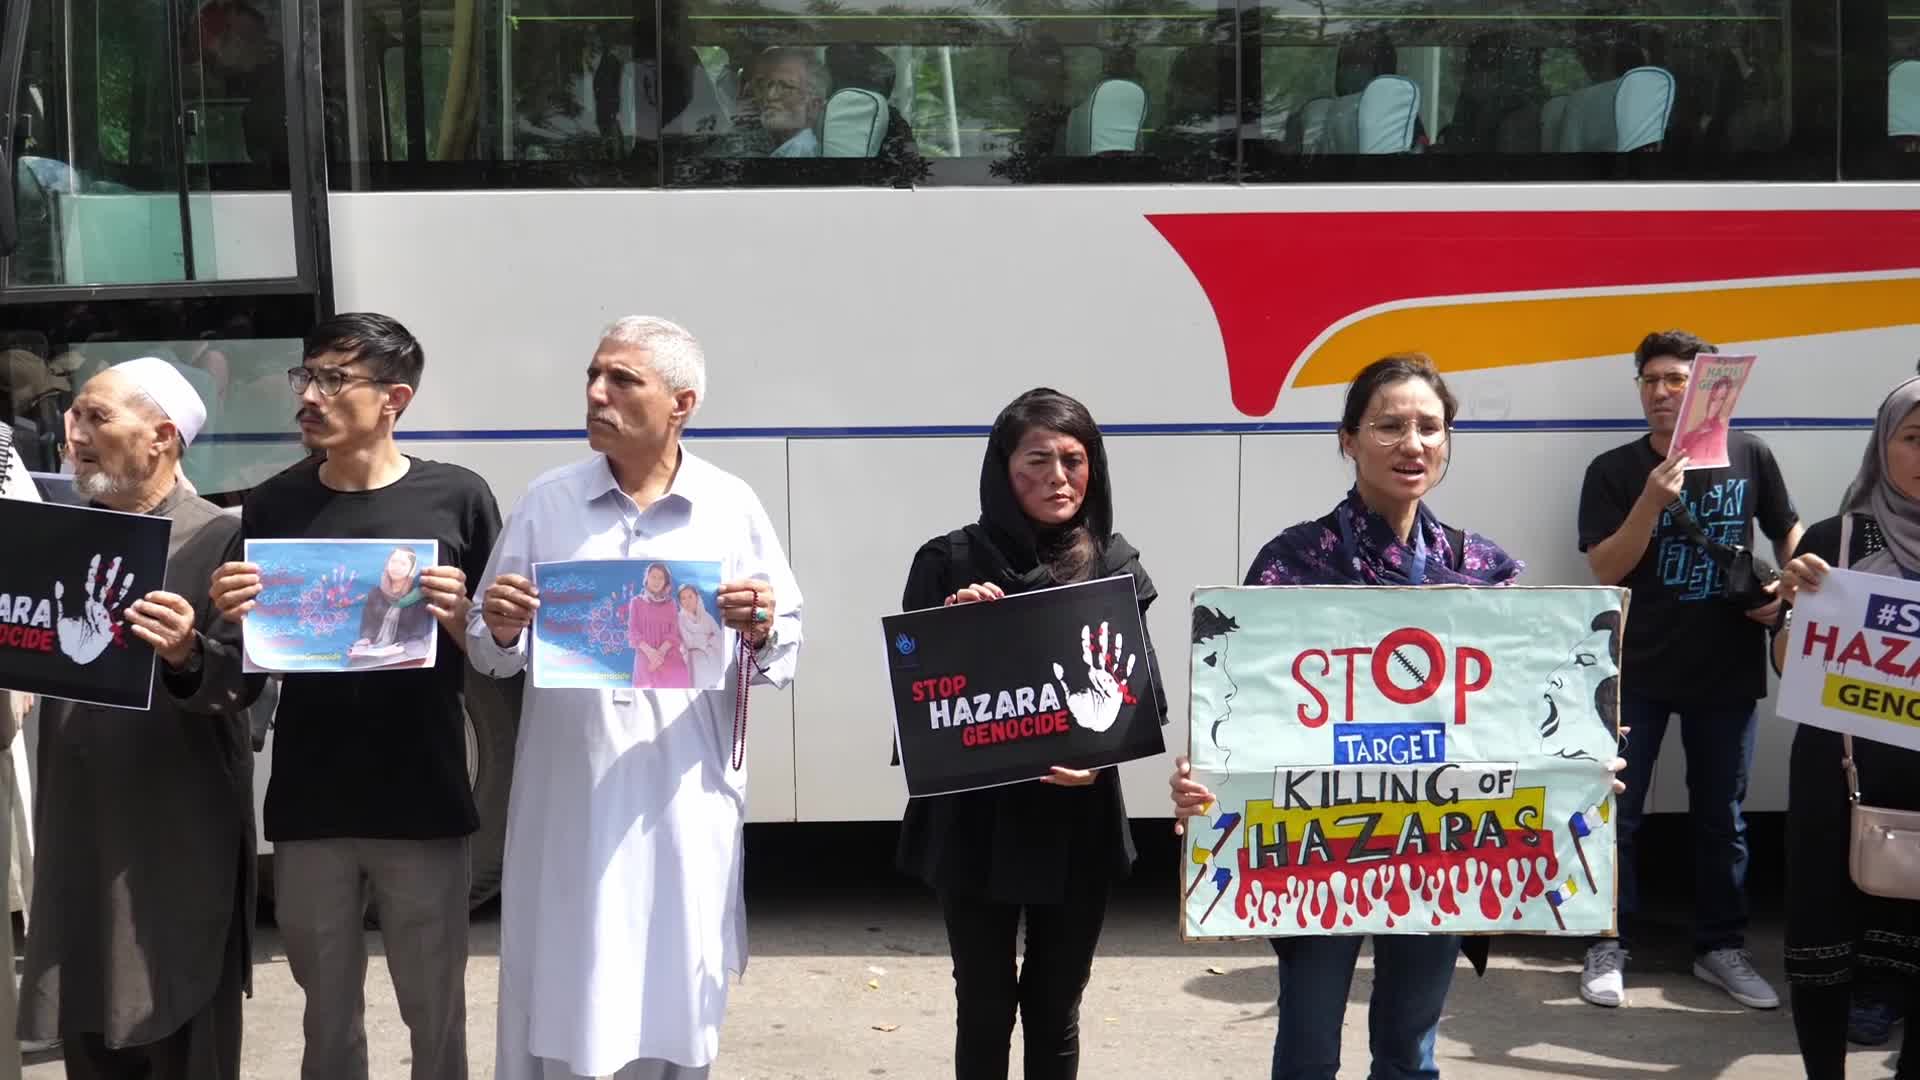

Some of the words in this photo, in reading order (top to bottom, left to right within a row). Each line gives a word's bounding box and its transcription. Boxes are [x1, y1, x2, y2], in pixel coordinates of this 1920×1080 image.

[912, 674, 967, 702] STOP
[1291, 627, 1493, 729] STOP
[929, 683, 1062, 730] HAZARA
[962, 709, 1071, 748] GENOCIDE
[1337, 729, 1442, 764] TARGET
[1283, 764, 1462, 812] KILLING
[1478, 769, 1514, 795] OF
[1248, 805, 1543, 871] HAZARAS
